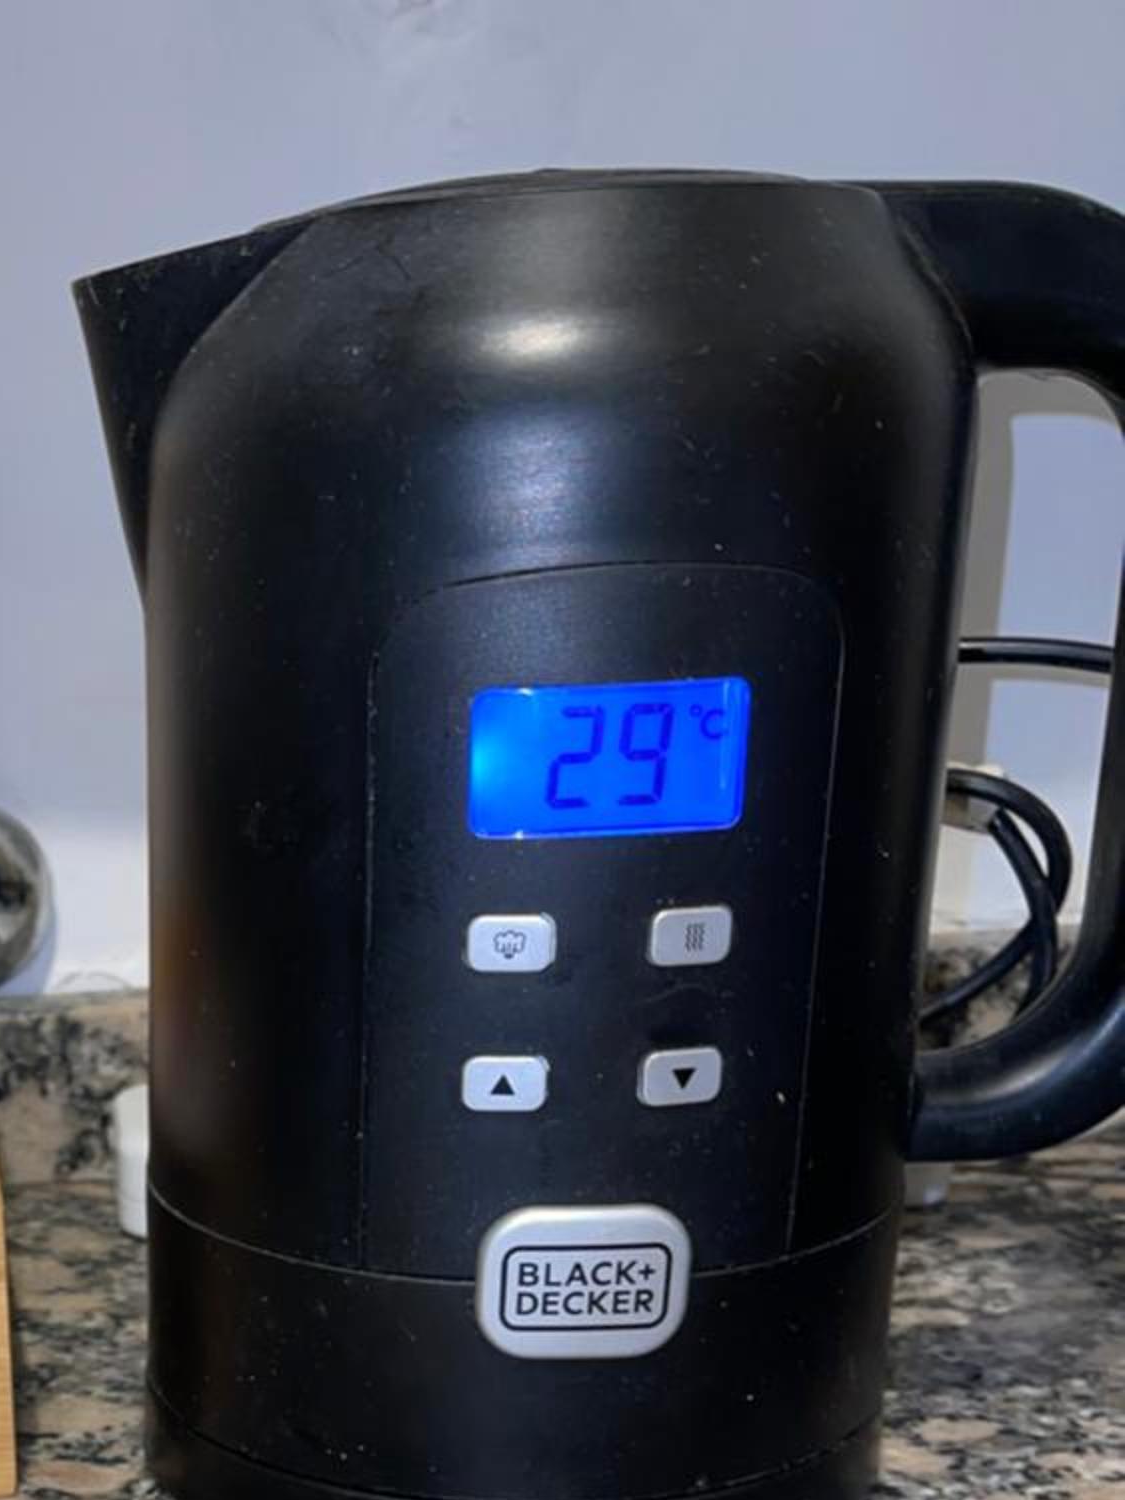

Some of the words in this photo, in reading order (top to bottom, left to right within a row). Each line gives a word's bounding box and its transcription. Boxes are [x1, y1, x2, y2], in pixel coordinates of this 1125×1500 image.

[545, 703, 674, 810] 29
[517, 1260, 656, 1287] BLACK+
[515, 1289, 654, 1316] DECKER
